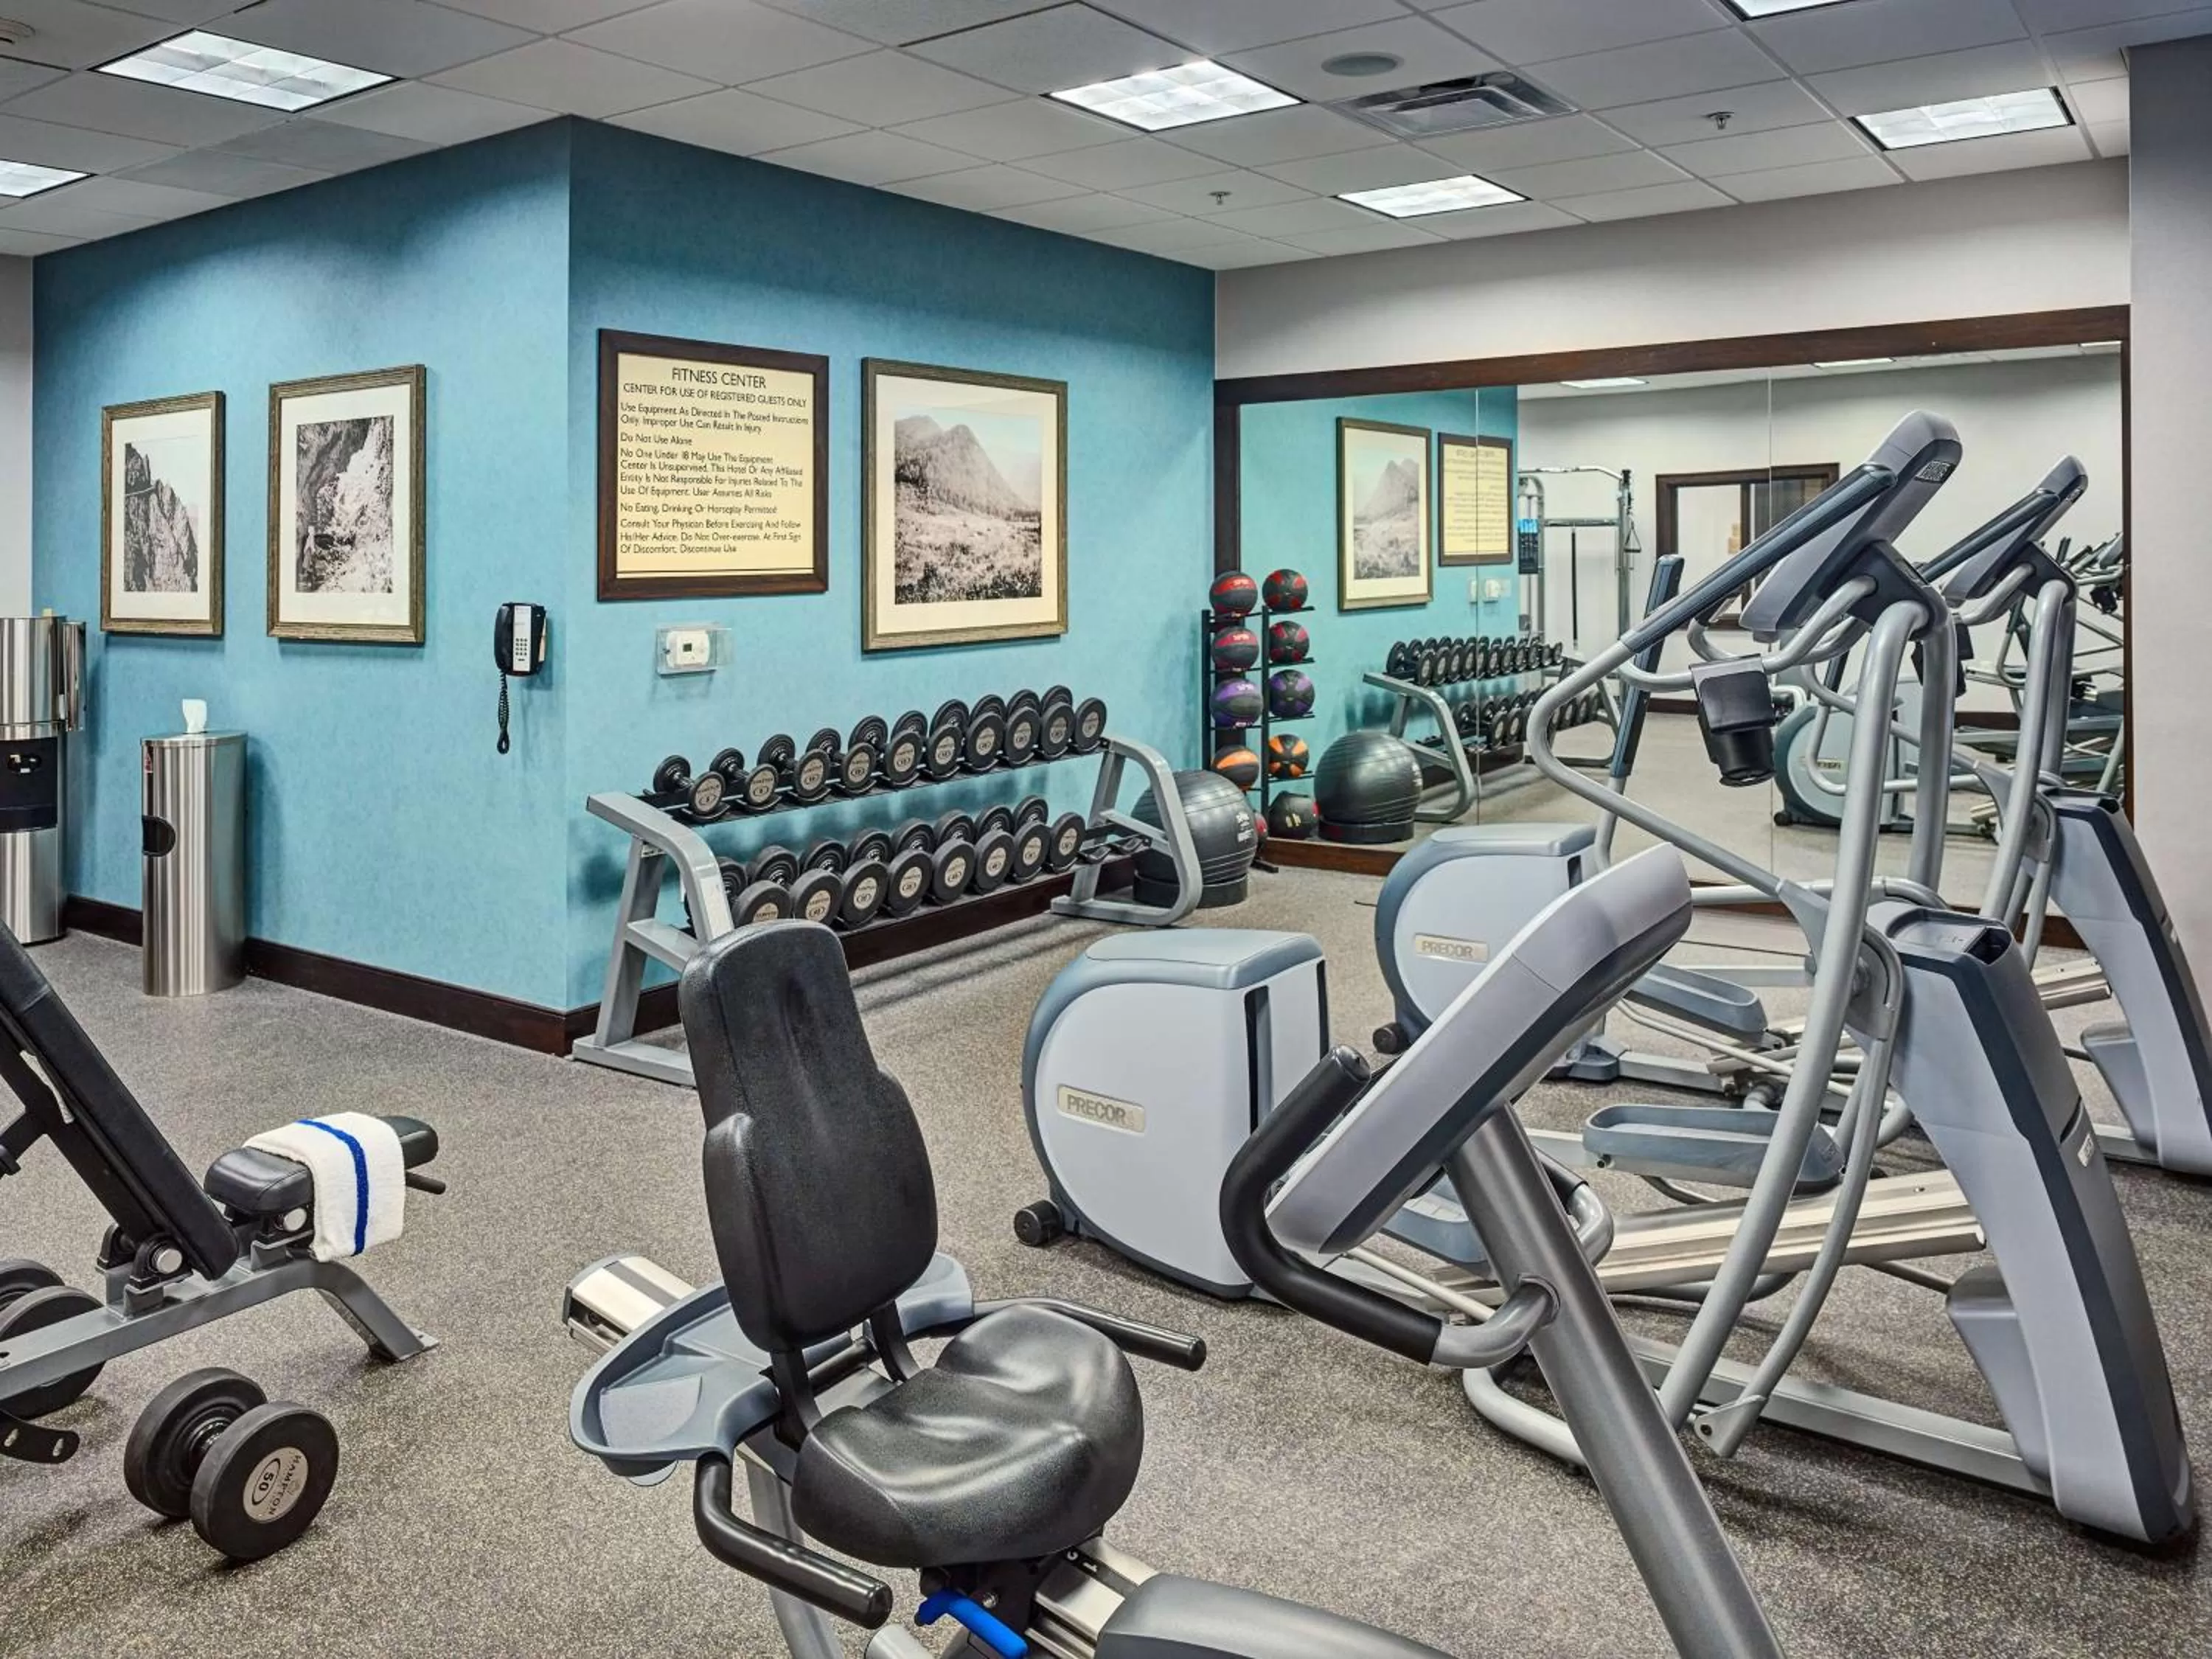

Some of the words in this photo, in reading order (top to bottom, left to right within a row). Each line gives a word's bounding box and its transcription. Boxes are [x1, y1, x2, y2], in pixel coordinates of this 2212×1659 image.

[672, 367, 717, 384] FITNESS
[721, 372, 766, 389] CENTER
[623, 383, 658, 394] CENTER
[660, 386, 678, 396] FOR
[680, 387, 695, 398] USE
[697, 389, 708, 399] OF
[710, 390, 756, 403] REGISTERED
[757, 394, 785, 406] GUESTS
[787, 397, 807, 408] ONLY
[620, 402, 636, 412] Use
[679, 406, 689, 416] As
[733, 409, 746, 420] The
[679, 417, 694, 428] Use
[695, 419, 712, 429] Can
[620, 431, 633, 442] Do
[636, 433, 651, 443] Not
[653, 434, 669, 445] Use
[620, 448, 633, 458] No
[635, 448, 653, 459] One
[654, 449, 678, 459] Under
[691, 451, 706, 463] May
[707, 452, 722, 462] Use
[723, 452, 737, 462] The
[620, 459, 647, 470] Center
[650, 461, 656, 470] Is
[748, 465, 757, 474] Or
[760, 465, 773, 477] Any
[653, 473, 669, 483] Not
[714, 476, 727, 484] For
[779, 477, 788, 487] To
[790, 478, 803, 487] The
[620, 484, 636, 495] Use
[638, 485, 648, 495] Of
[744, 489, 754, 498] All
[620, 502, 633, 512] No
[694, 504, 706, 512] Or
[651, 518, 670, 529] Your
[672, 518, 704, 530] Physician
[706, 518, 729, 529] Before
[765, 520, 779, 529] And
[681, 532, 693, 541] Do
[694, 532, 711, 541] Not
[620, 543, 632, 554] Of
[723, 543, 737, 553] Use
[1420, 940, 1474, 959] PRECOR
[1066, 1093, 1126, 1125] PRECOR
[258, 1472, 274, 1492] 50
[268, 1455, 302, 1515] HAMPTON
